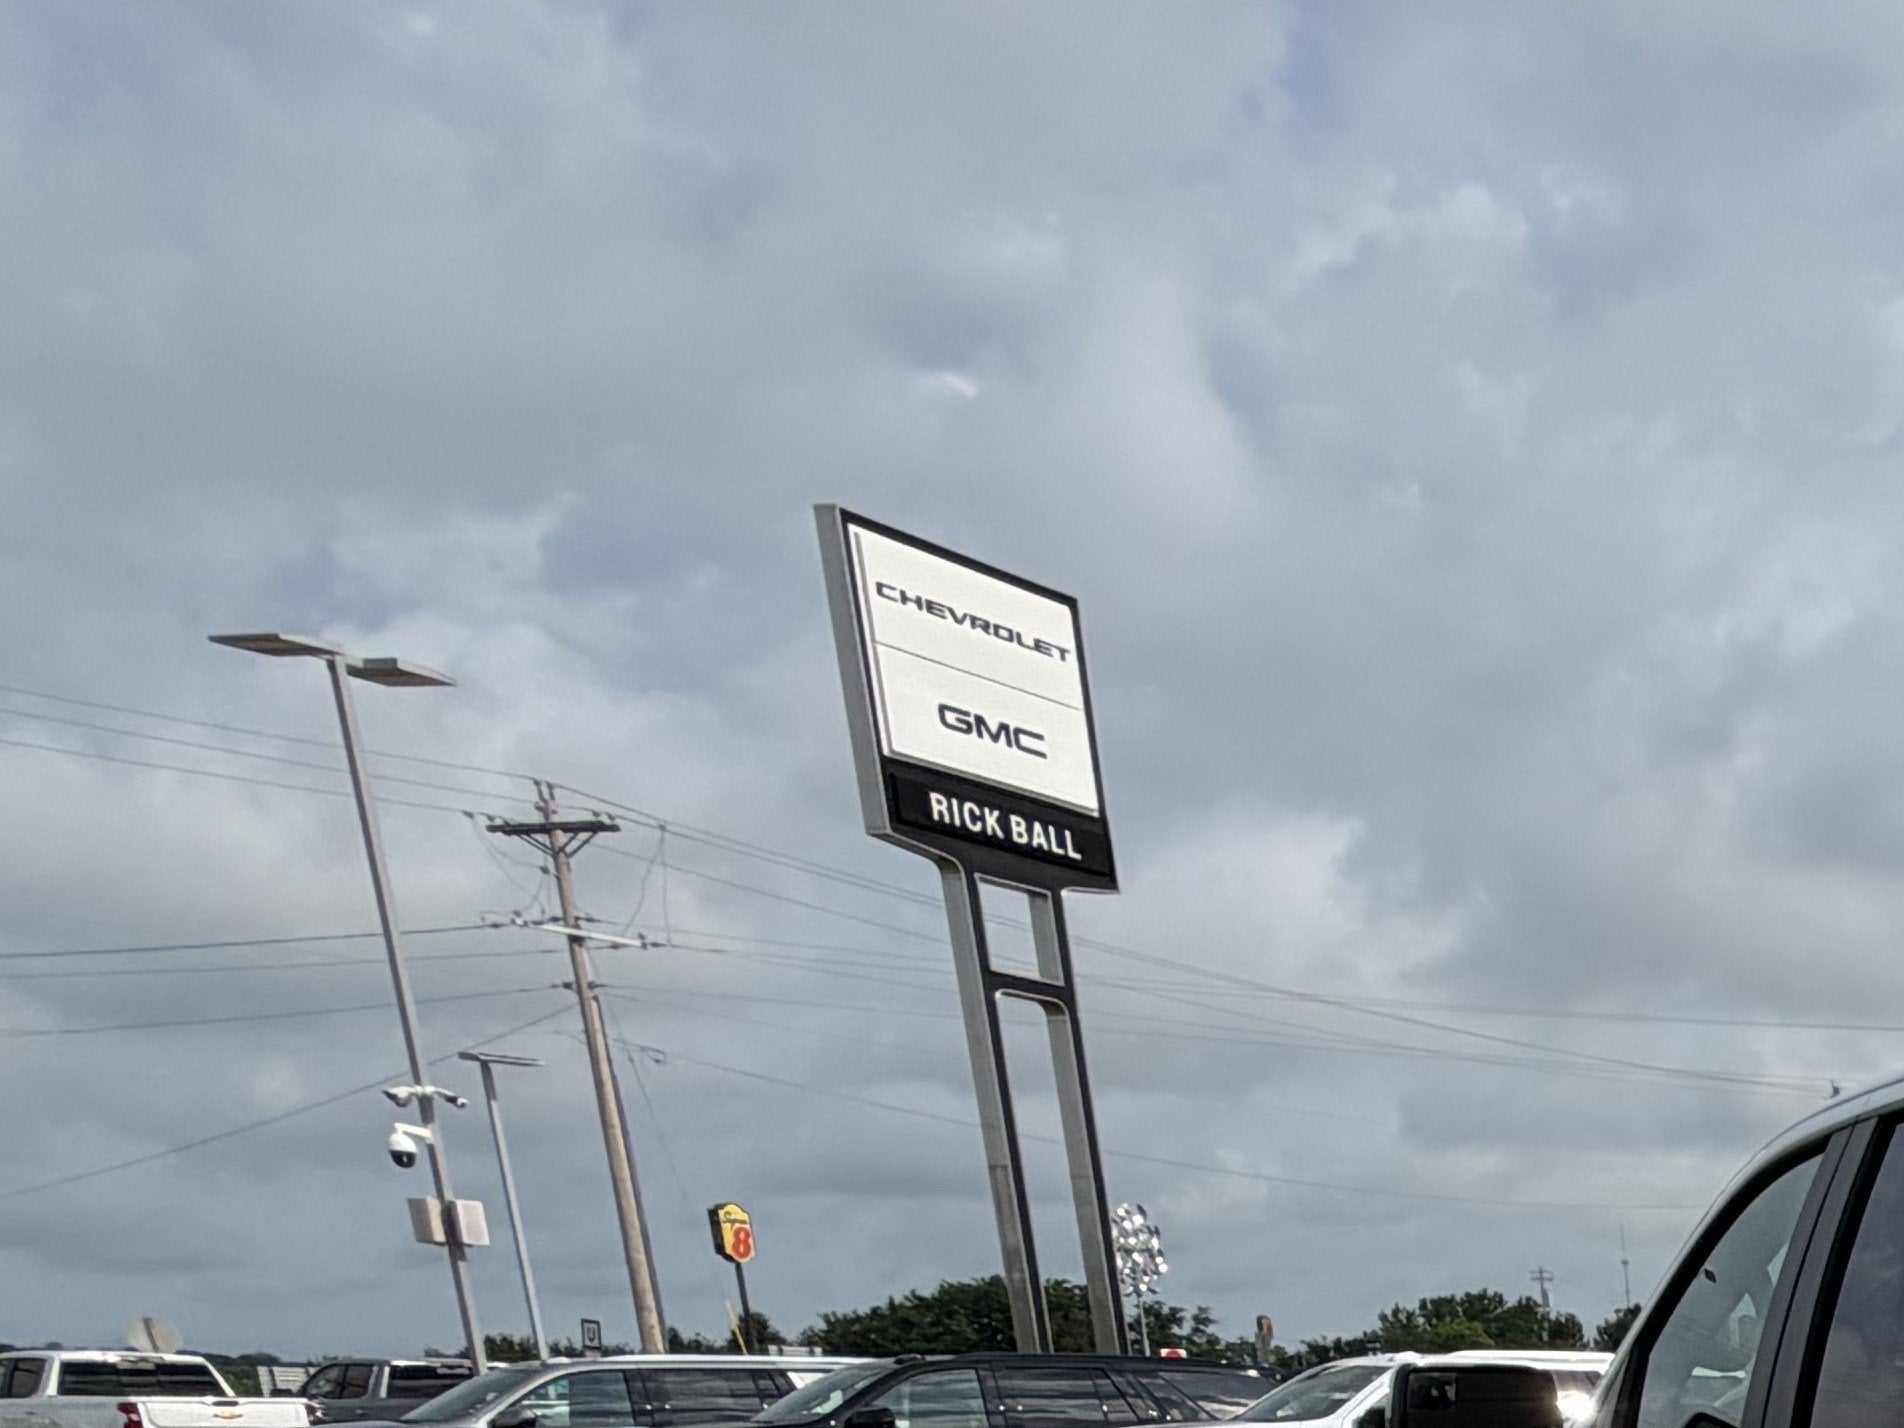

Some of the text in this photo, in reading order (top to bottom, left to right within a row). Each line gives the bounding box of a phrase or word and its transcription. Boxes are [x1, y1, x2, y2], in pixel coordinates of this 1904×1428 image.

[876, 581, 1071, 662] CHEVROLET
[938, 703, 1048, 759] GMC
[929, 792, 1082, 860] RICK BALL
[732, 1227, 751, 1259] 8
